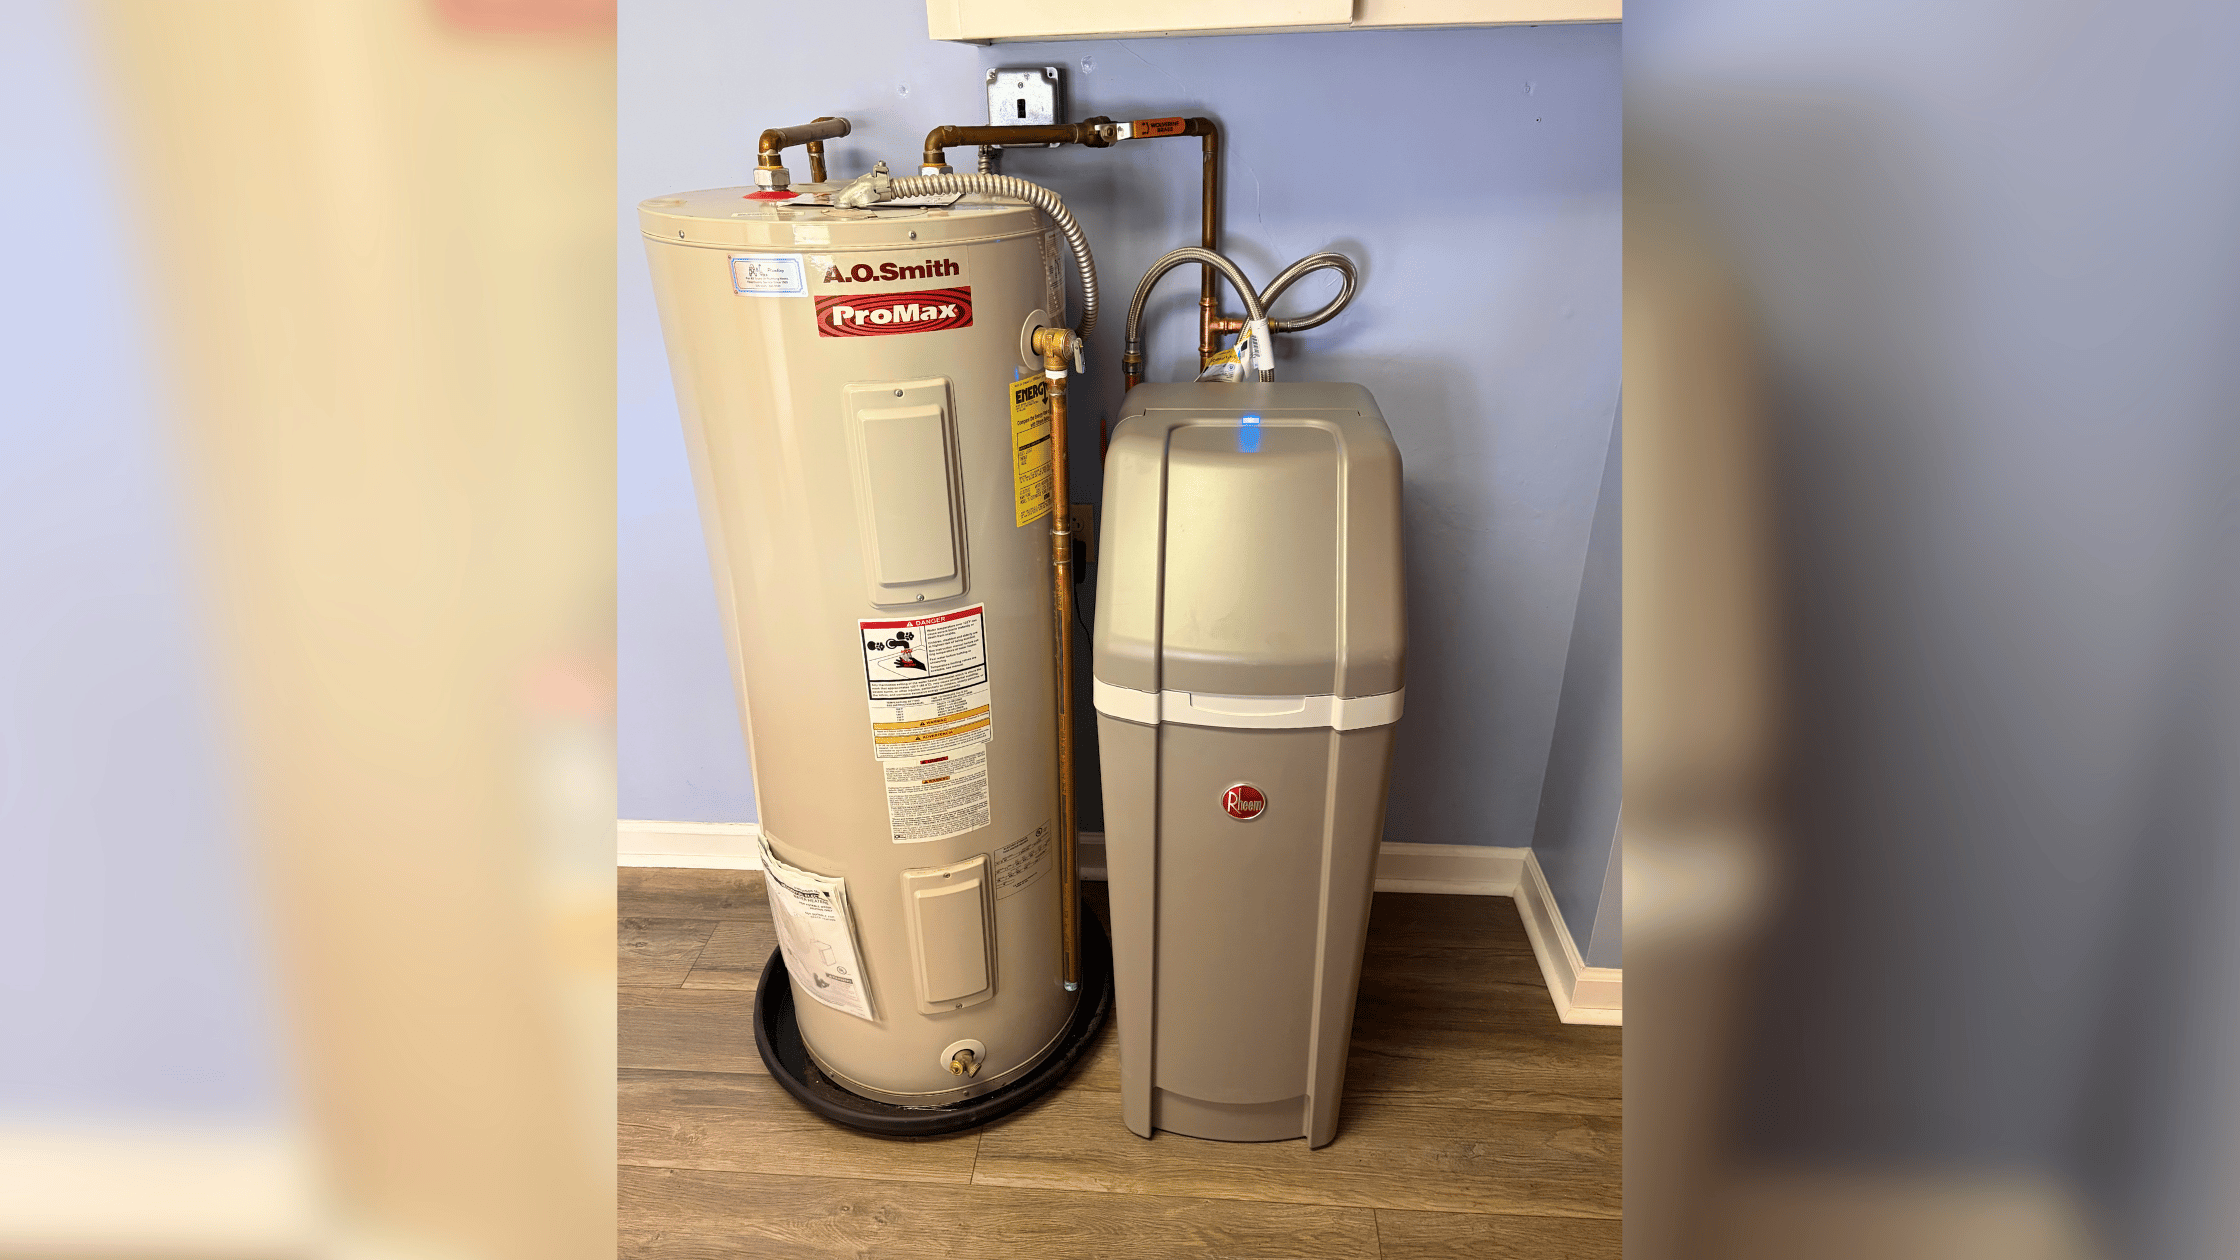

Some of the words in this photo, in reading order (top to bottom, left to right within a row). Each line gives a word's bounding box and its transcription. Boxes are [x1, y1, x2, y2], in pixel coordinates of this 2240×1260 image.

[832, 304, 957, 326] ProMax
[916, 616, 946, 626] DANGER
[1227, 788, 1262, 814] Rheem
